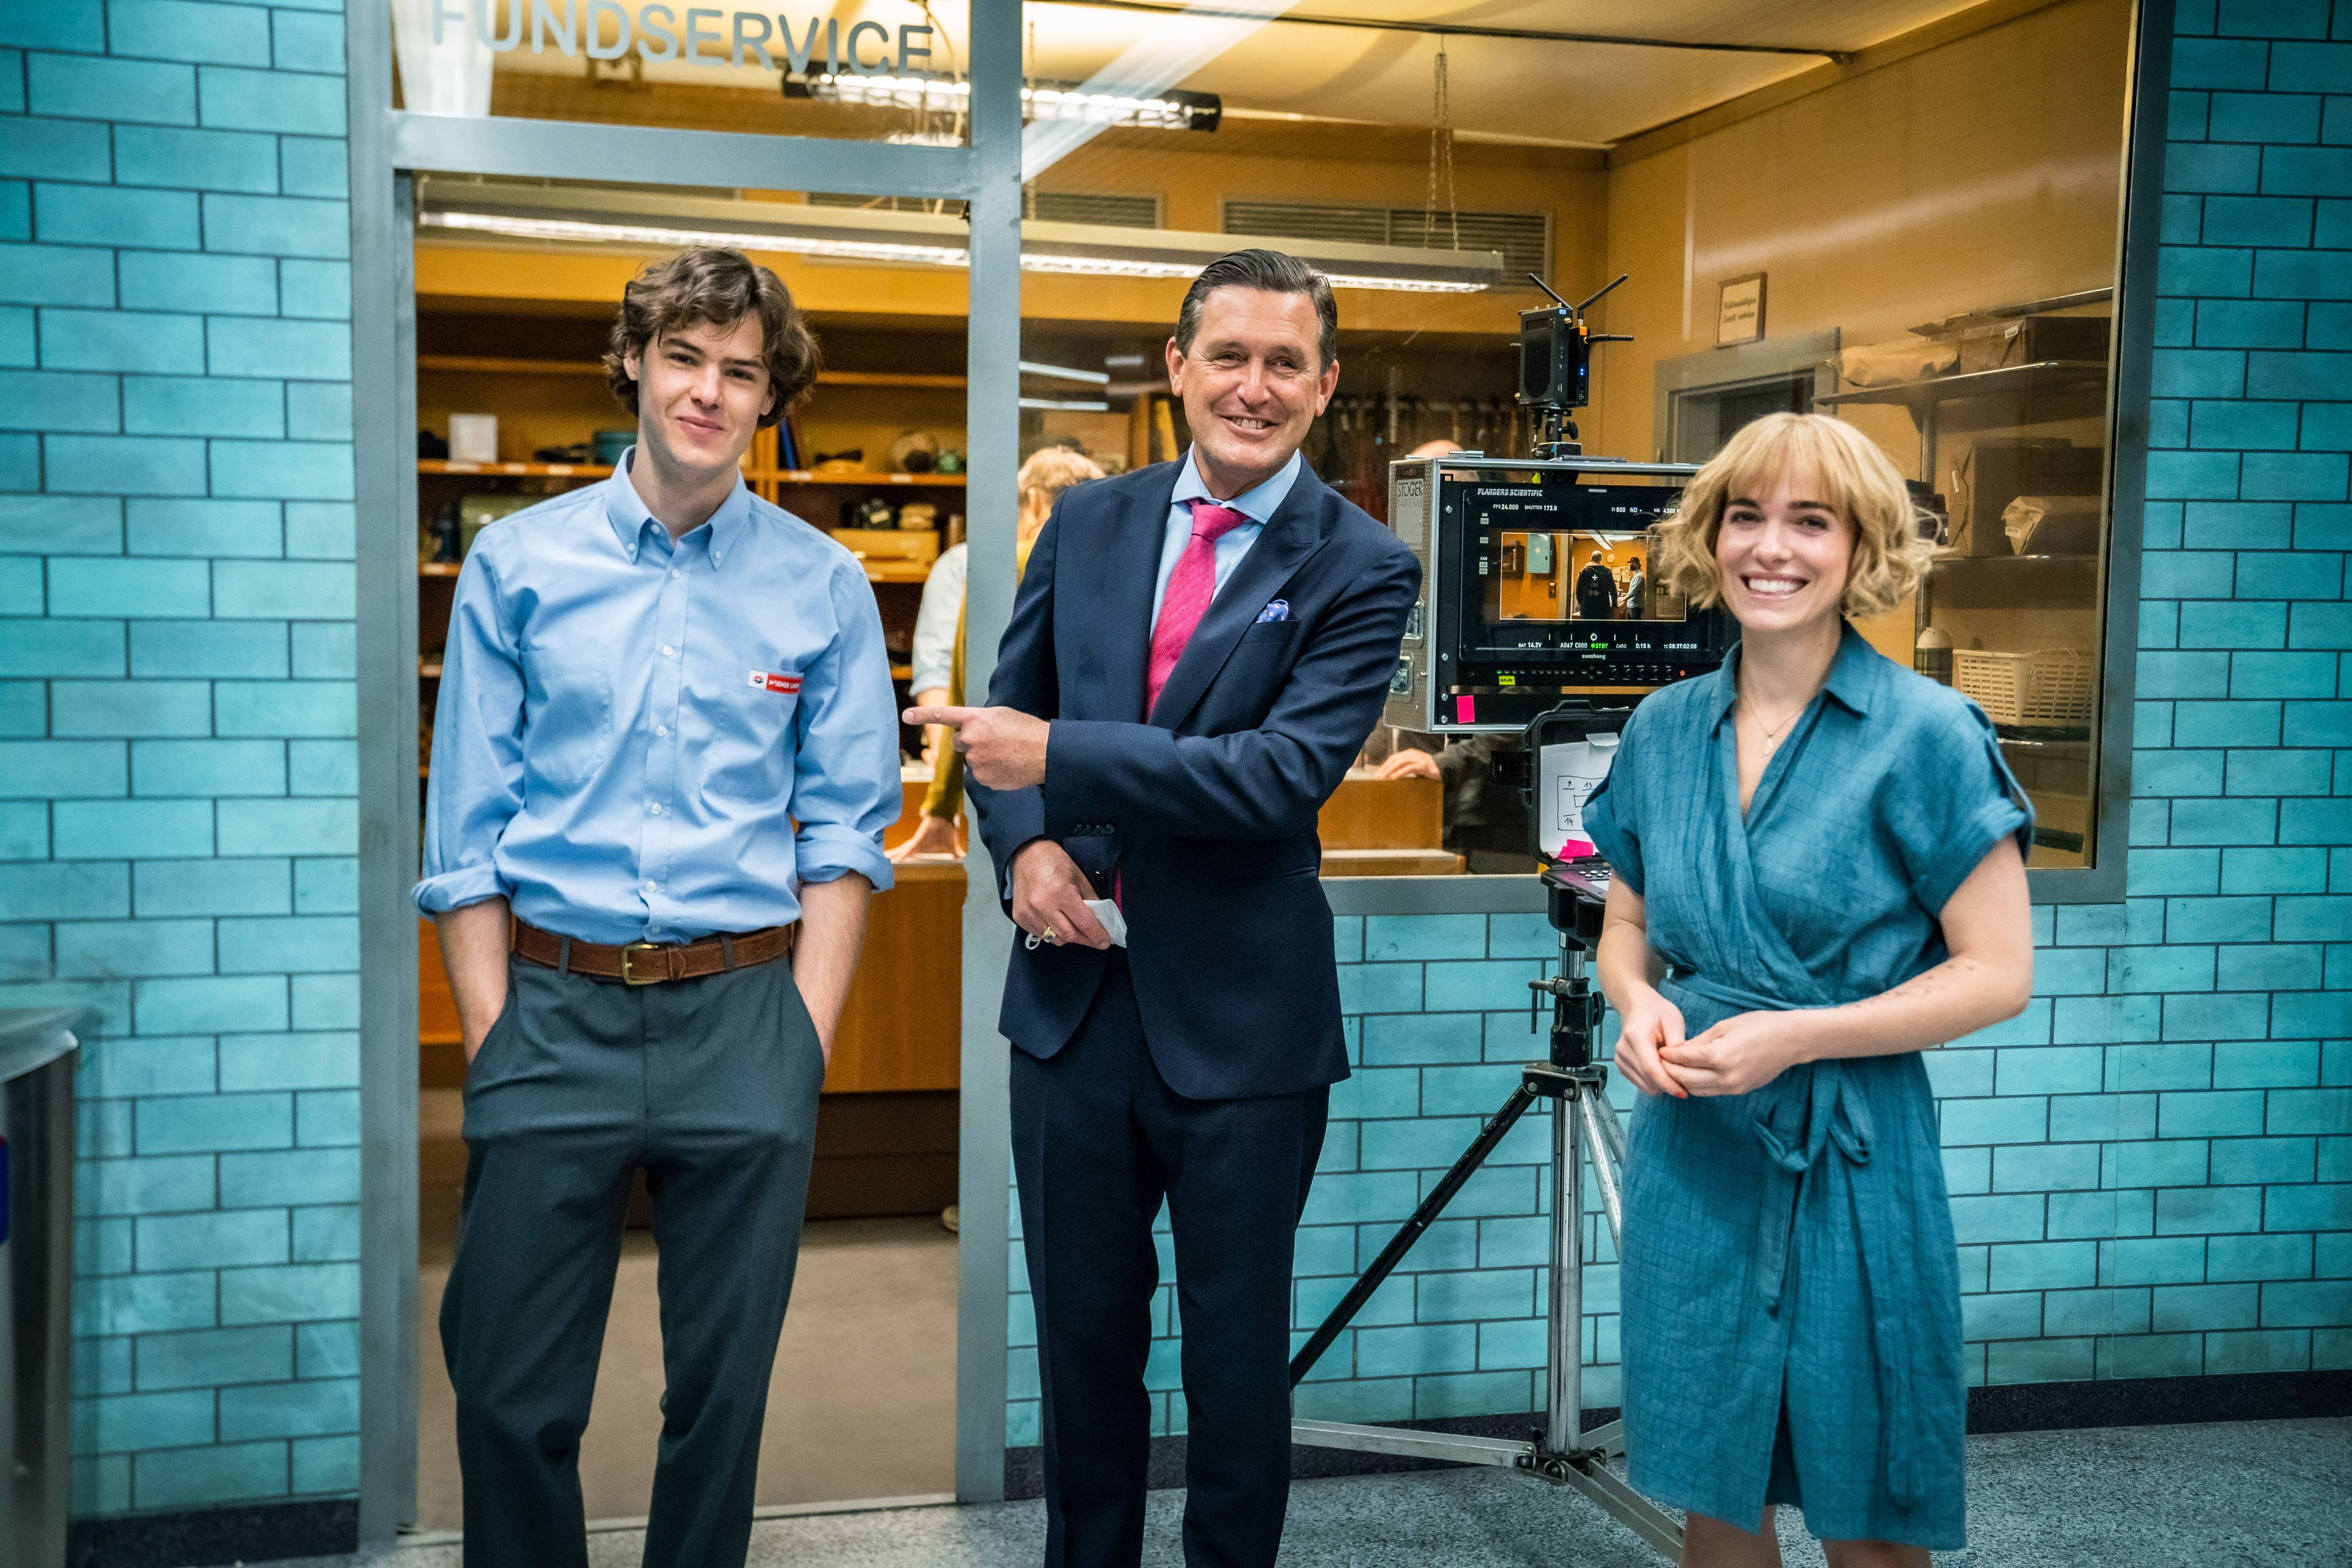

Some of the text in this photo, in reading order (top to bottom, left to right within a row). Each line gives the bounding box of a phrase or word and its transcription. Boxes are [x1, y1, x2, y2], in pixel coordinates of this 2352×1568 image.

[432, 0, 934, 78] FUNDSERVICE
[1477, 488, 1543, 497] FLANDERS SCIENTIFIC
[1564, 817, 1573, 826] 14
